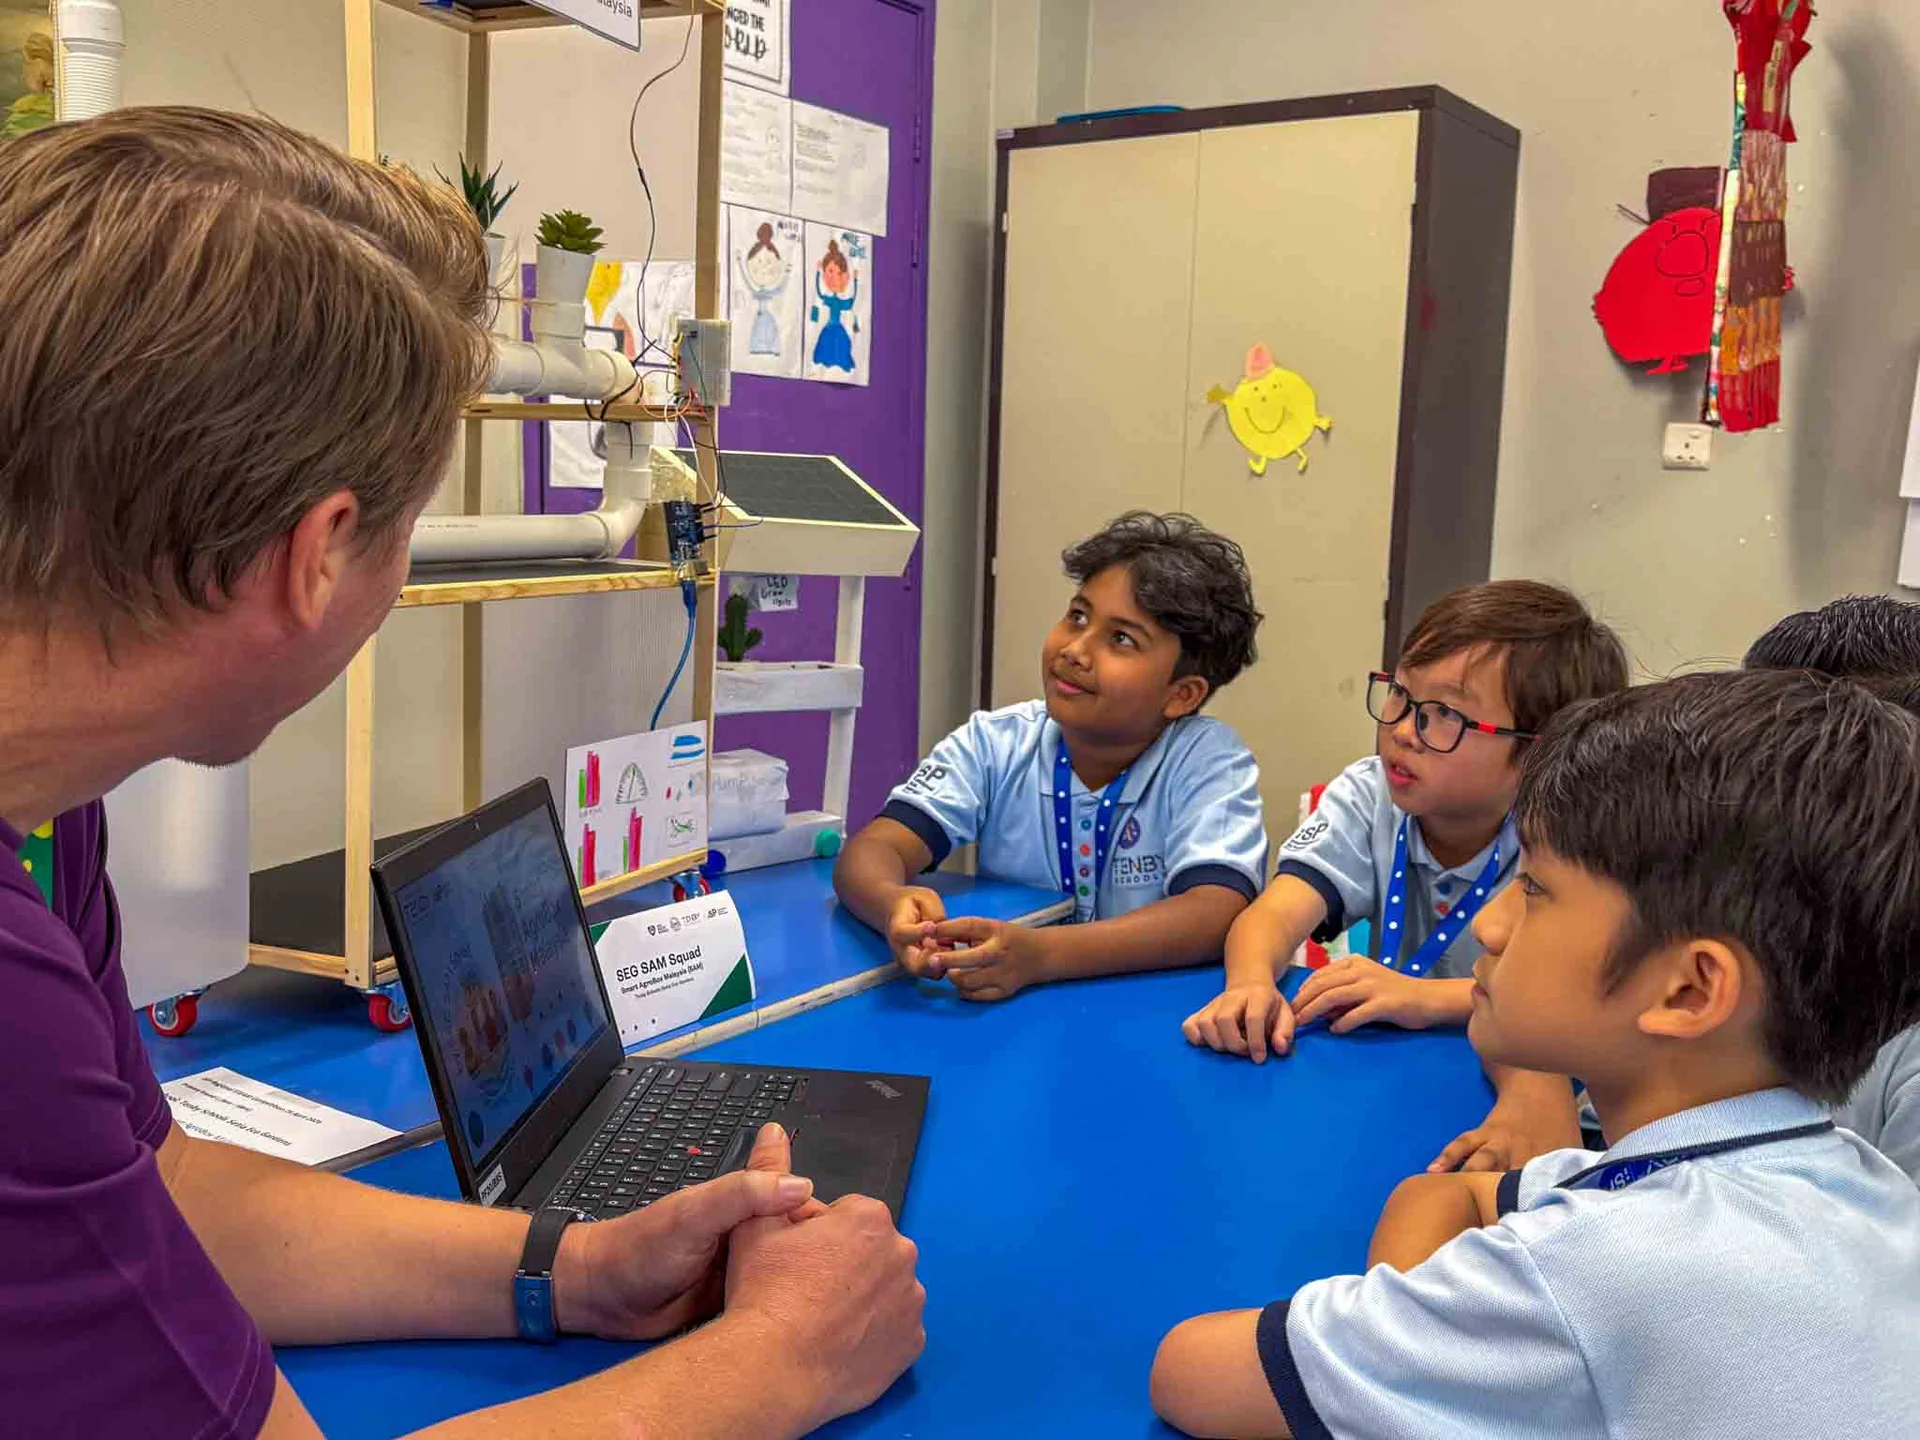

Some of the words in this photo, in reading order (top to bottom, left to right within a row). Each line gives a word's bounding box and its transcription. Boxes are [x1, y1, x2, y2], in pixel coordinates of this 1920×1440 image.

[751, 13, 765, 32] THE
[616, 964, 639, 982] SEG
[640, 956, 667, 975] SAM
[668, 945, 701, 966] Squad
